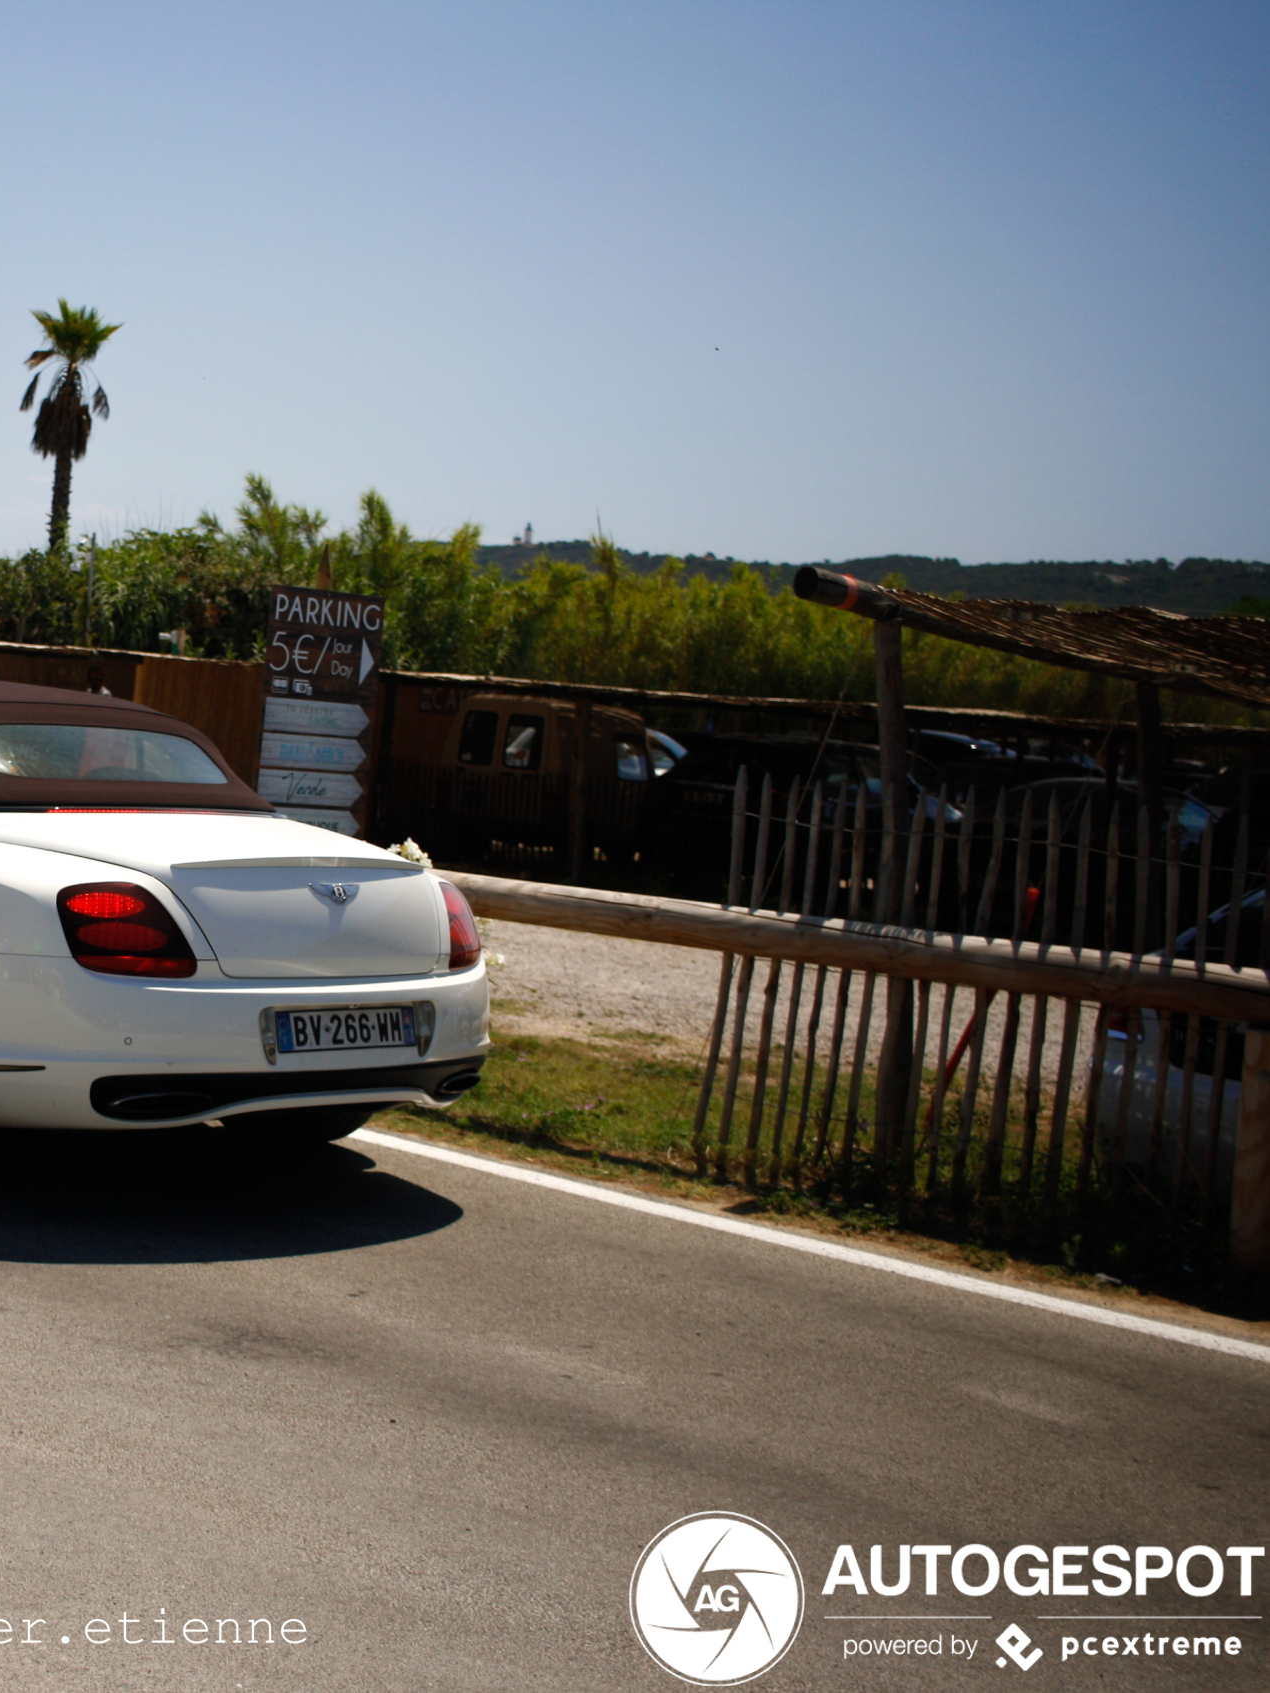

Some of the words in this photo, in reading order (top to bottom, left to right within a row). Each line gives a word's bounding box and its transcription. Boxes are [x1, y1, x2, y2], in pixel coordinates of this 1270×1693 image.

[275, 594, 381, 631] PARKING
[332, 638, 353, 655] Jour
[331, 660, 353, 679] Day
[282, 772, 327, 801] Verde
